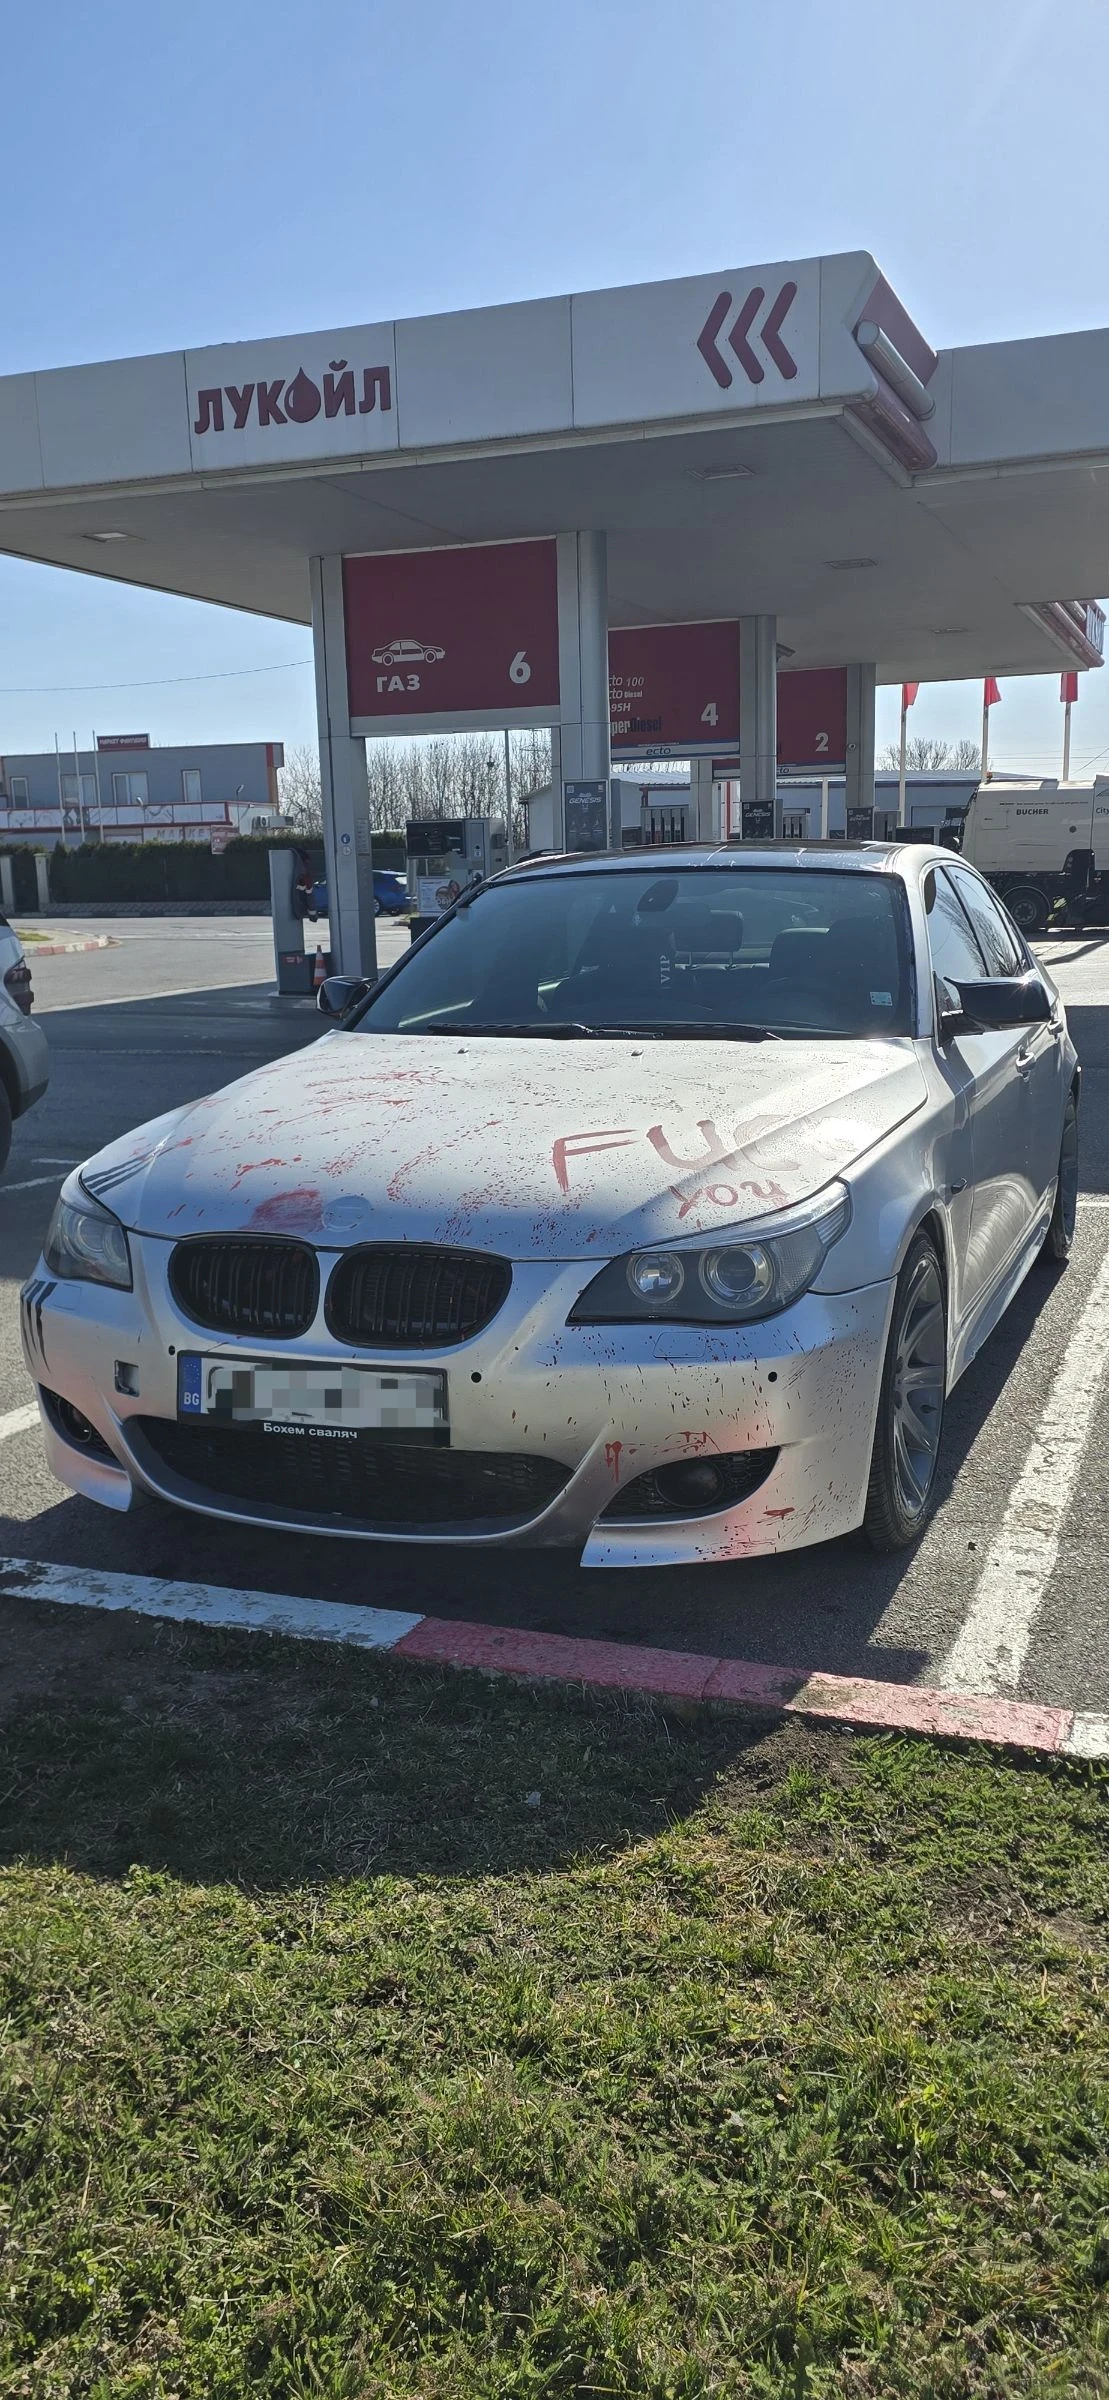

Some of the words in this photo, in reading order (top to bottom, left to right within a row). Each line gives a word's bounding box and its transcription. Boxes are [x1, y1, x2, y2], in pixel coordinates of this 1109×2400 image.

[194, 359, 392, 435] ЛУКОЙЛ
[509, 651, 531, 684] 6
[376, 674, 421, 692] ГАЗ
[626, 676, 645, 687] 100
[701, 703, 719, 726] 4
[646, 746, 671, 756] ecto
[815, 732, 829, 752] 2
[1016, 808, 1049, 816] BUCHER
[183, 1391, 200, 1406] BG
[263, 1421, 305, 1436] Бохем
[308, 1427, 358, 1440] сваляч
